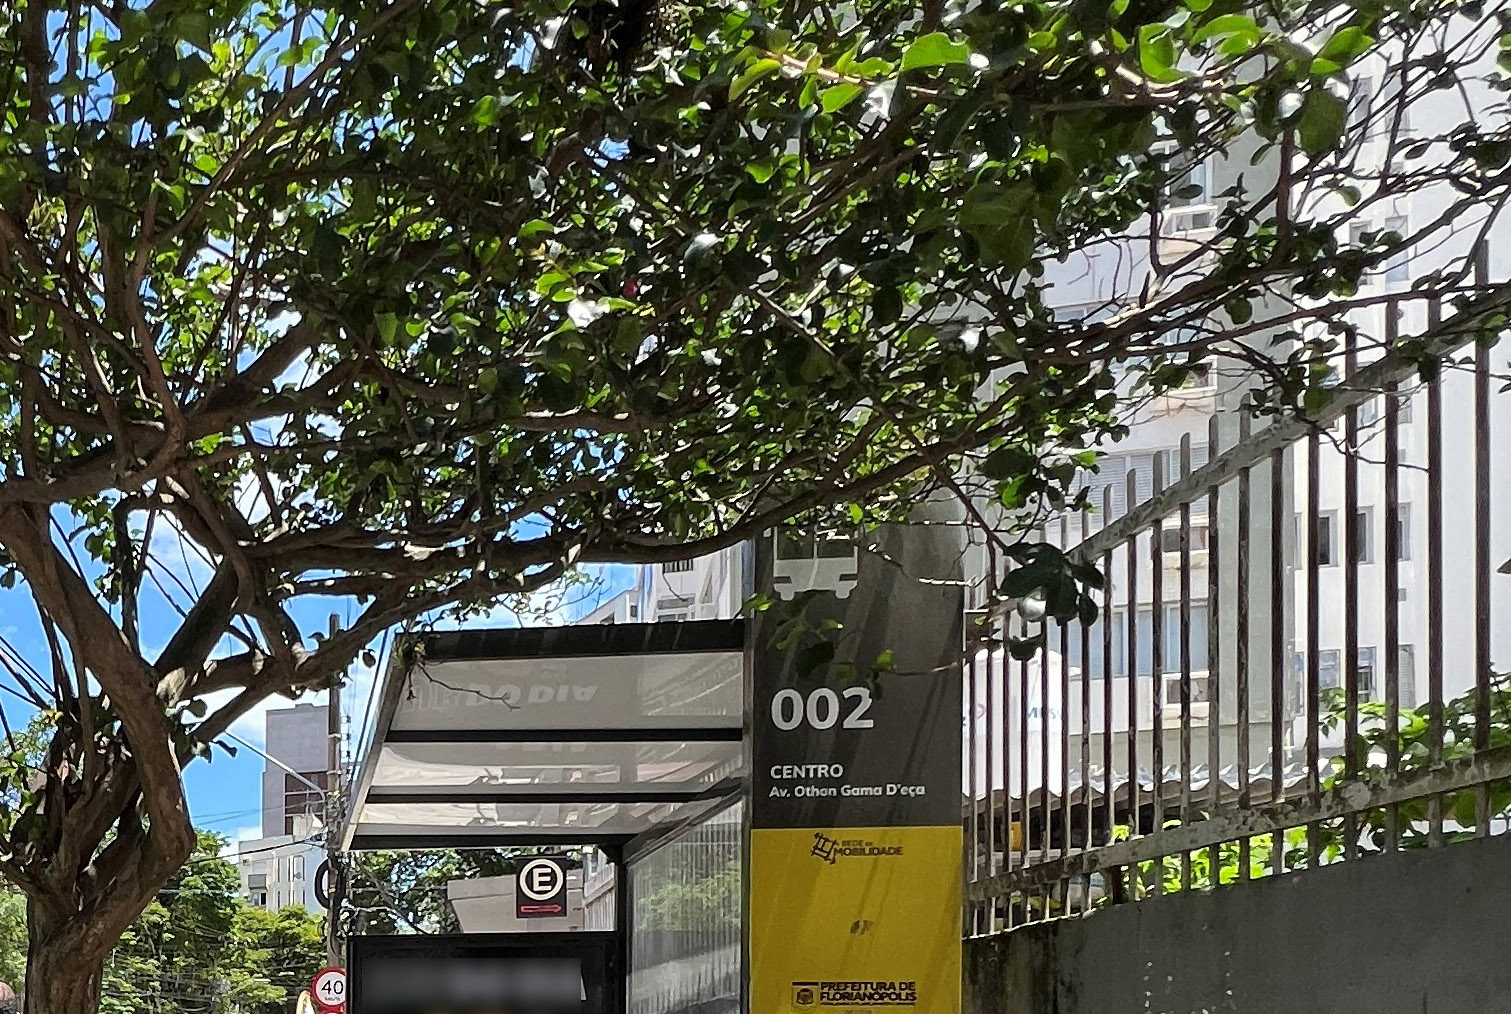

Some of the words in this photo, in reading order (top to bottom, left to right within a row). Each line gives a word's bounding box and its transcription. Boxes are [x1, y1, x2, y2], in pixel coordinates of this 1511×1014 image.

[771, 687, 874, 730] 002
[770, 764, 844, 779] CENTRO
[769, 786, 791, 798] Av.
[794, 785, 837, 797] Othon
[840, 784, 882, 796] Gama
[533, 868, 552, 891] E
[321, 980, 344, 995] 40
[820, 981, 896, 991] PREFEITURA
[899, 981, 916, 991] DE
